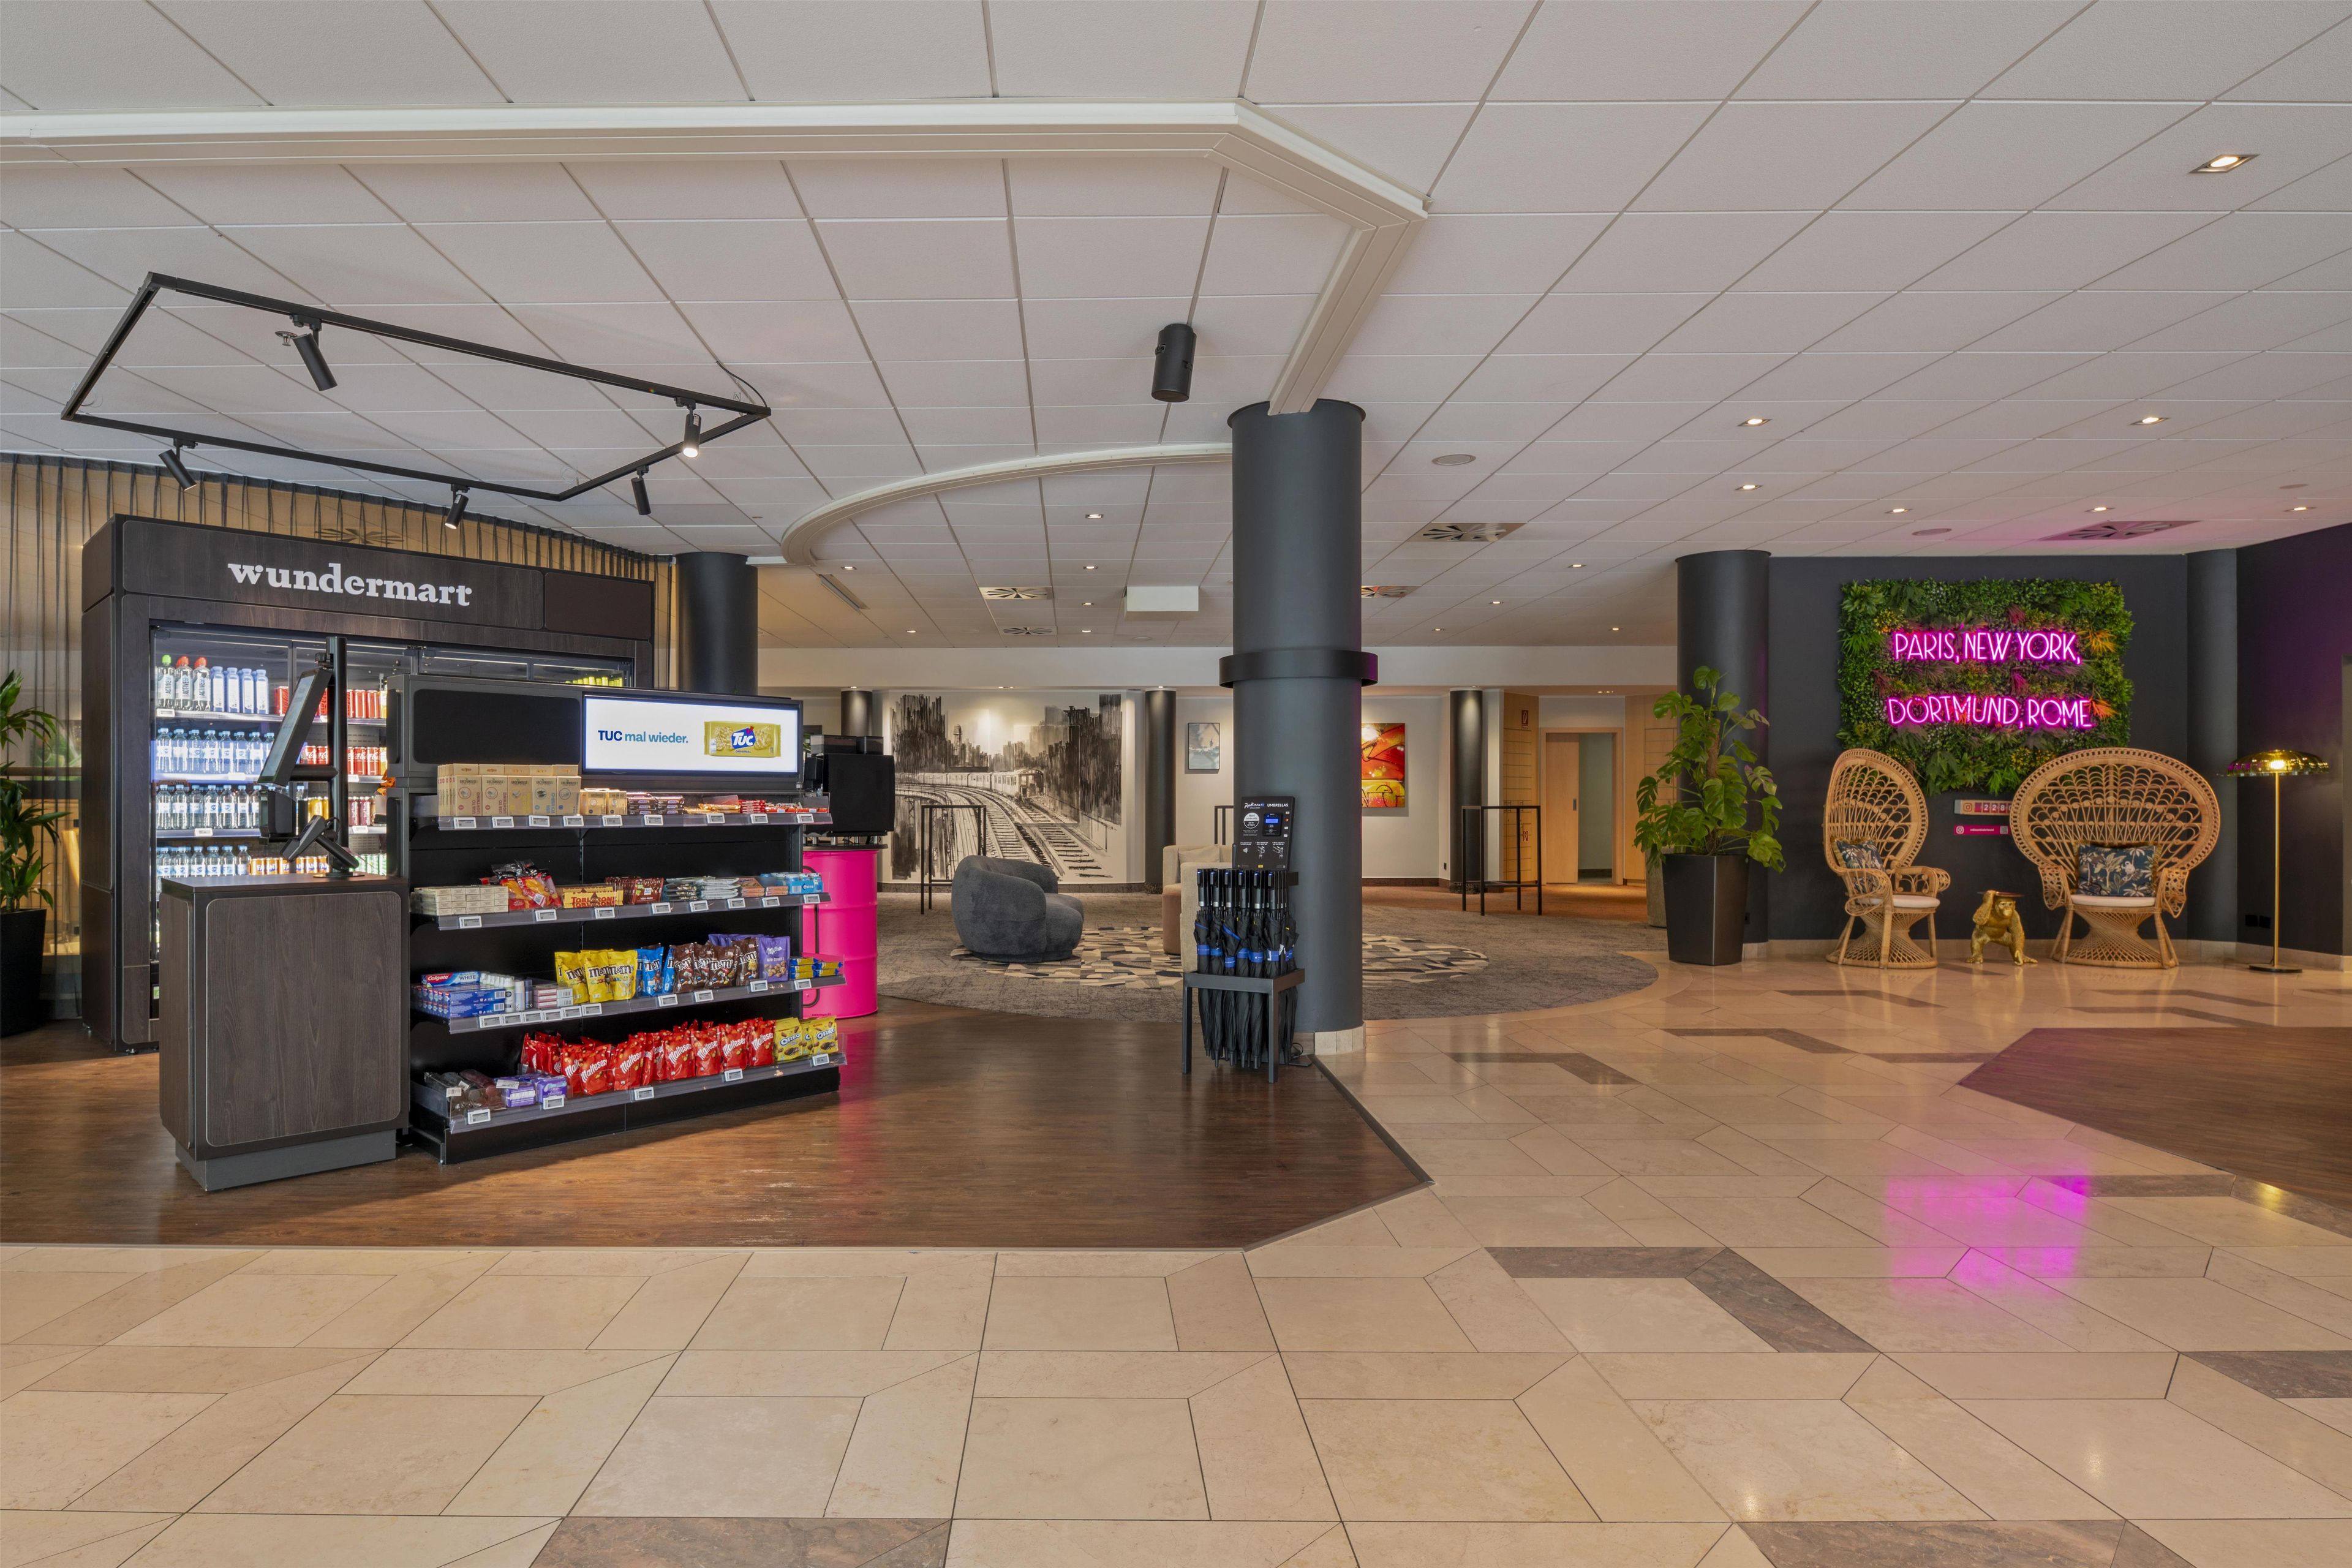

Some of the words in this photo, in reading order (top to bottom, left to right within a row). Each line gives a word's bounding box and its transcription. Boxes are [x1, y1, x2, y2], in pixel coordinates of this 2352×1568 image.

[227, 562, 472, 606] wundermart
[1894, 631, 1960, 664] PARIS,
[1964, 631, 2011, 661] NEW
[2017, 632, 2082, 665] YORK,
[1887, 695, 2024, 729] DORTMUND,
[2027, 699, 2092, 728] ROME
[598, 730, 622, 741] TUC
[625, 731, 646, 742] mal
[649, 732, 688, 744] wieder.
[722, 1038, 745, 1057] Malteser
[752, 1033, 774, 1050] Malteser
[581, 1059, 608, 1083] Maltesers
